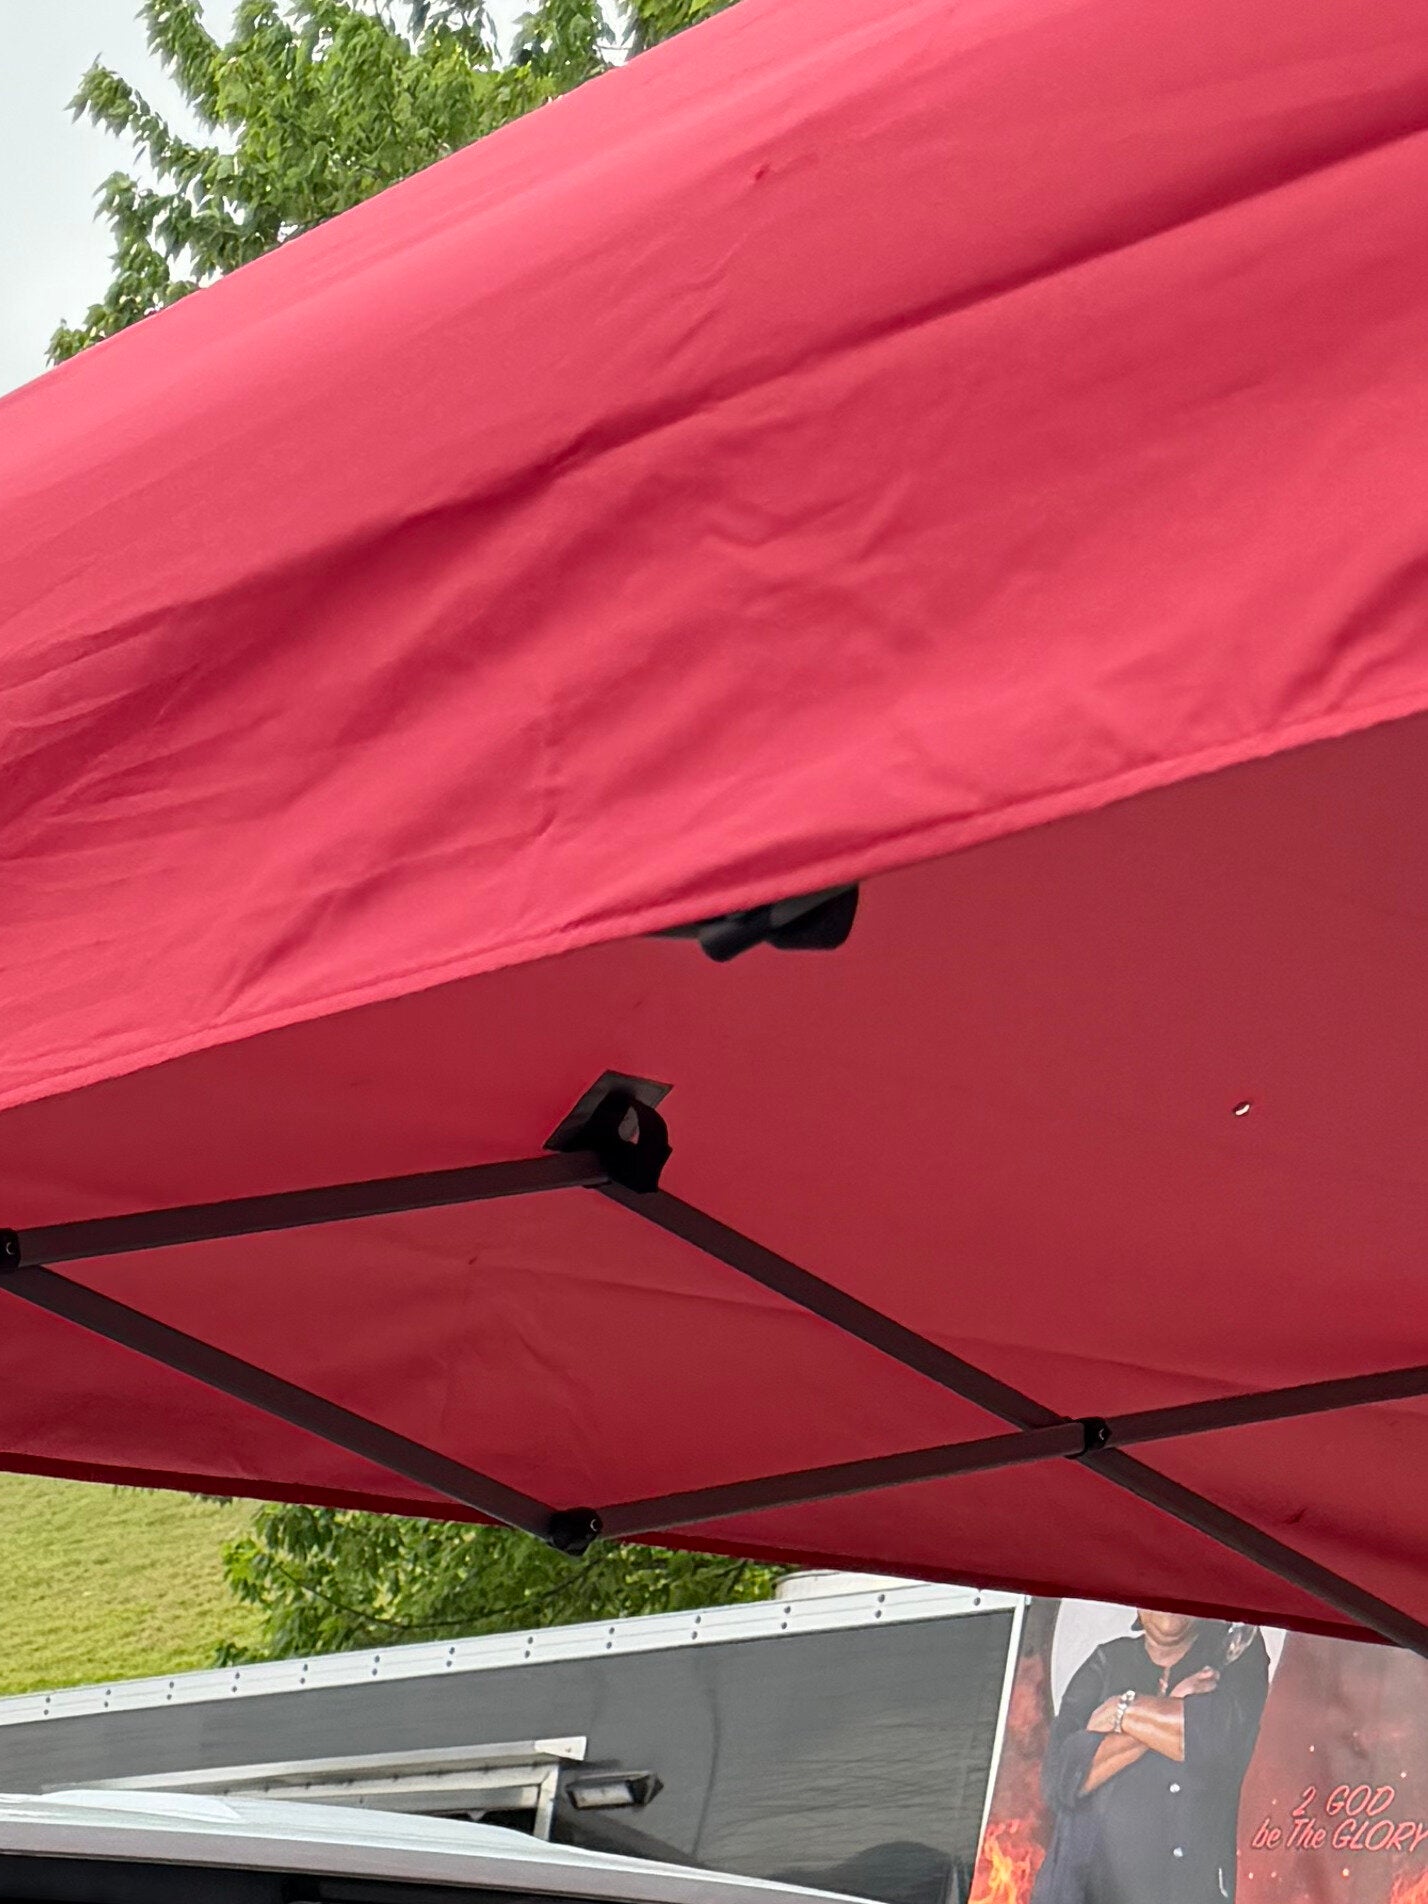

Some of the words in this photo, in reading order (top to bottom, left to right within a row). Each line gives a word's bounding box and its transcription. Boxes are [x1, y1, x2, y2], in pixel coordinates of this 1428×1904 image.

[1292, 1785, 1316, 1816] 2
[1325, 1784, 1394, 1816] GOD
[1251, 1817, 1282, 1849] be
[1286, 1817, 1327, 1849] The
[1331, 1818, 1428, 1852] GLORY
